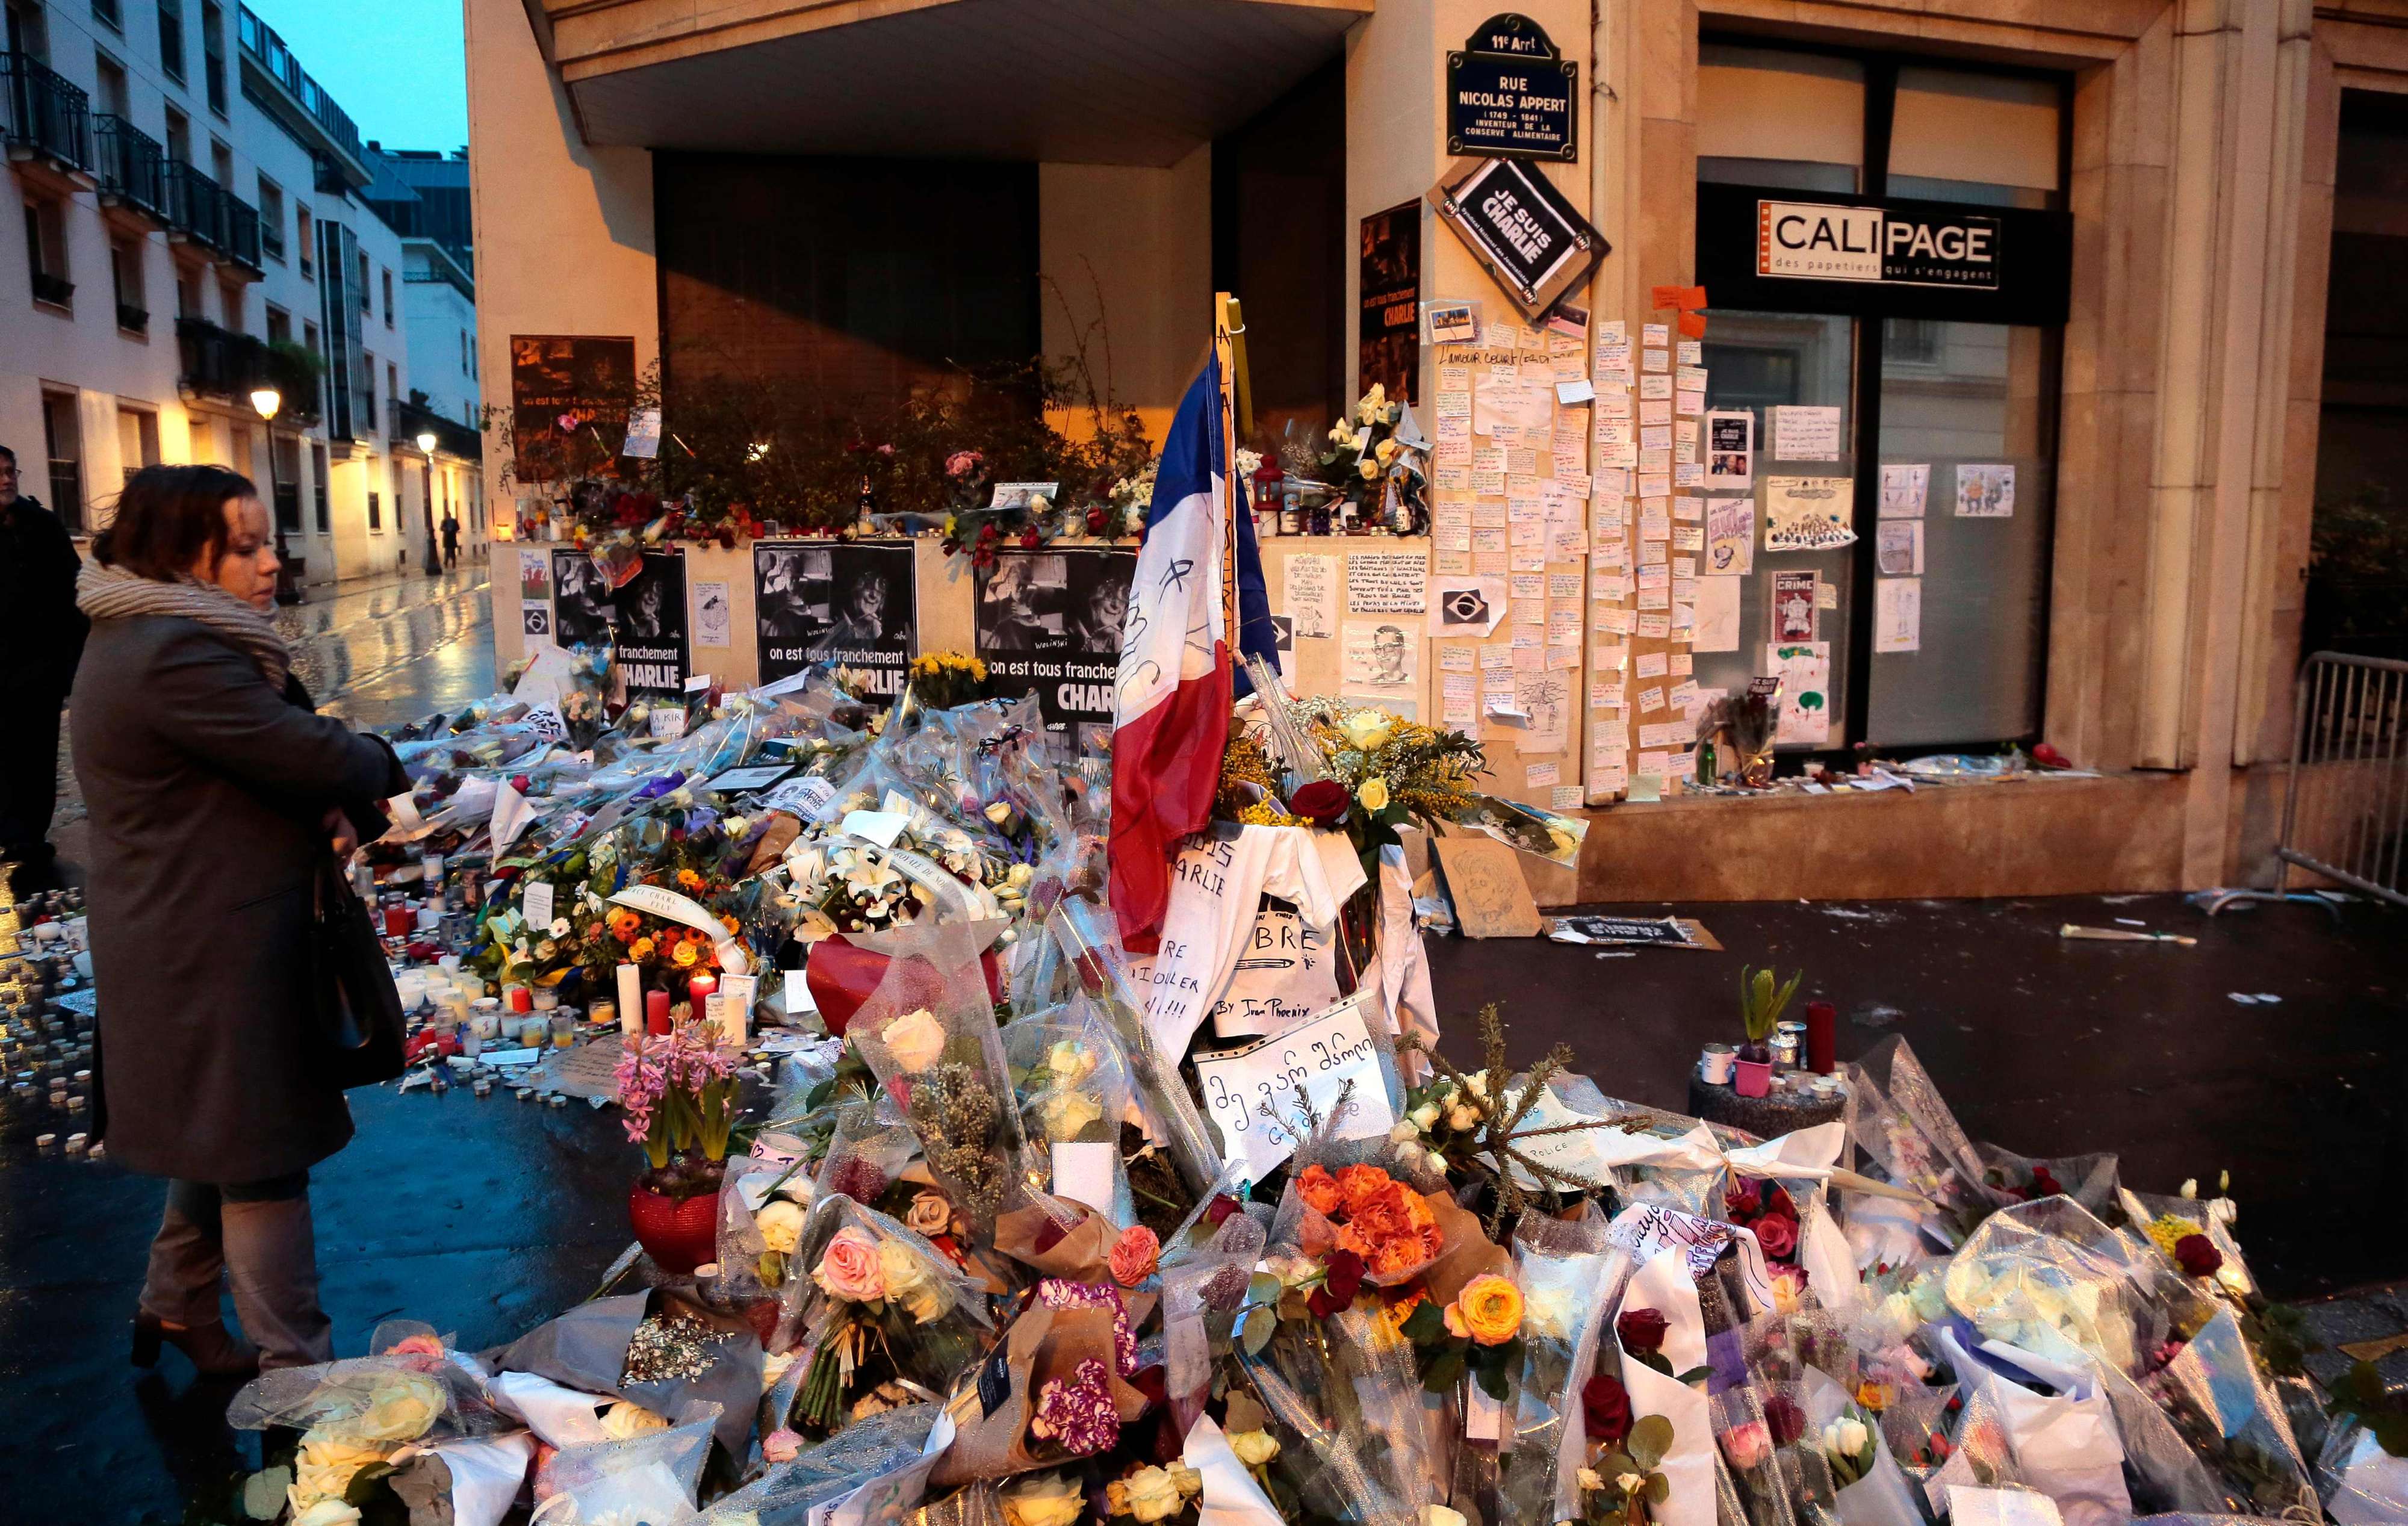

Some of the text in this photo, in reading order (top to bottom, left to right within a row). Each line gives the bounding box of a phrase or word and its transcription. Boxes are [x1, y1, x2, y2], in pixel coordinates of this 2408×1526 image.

[1500, 76, 1528, 91] RUE
[1459, 91, 1566, 112] NICOLAS APPERT
[1476, 119, 1517, 129] INVENTEUR
[1465, 127, 1561, 141] CONSERVE ALIMENTAIRE
[1495, 190, 1552, 249] JE SUIS
[1482, 197, 1543, 265] CHARLIE
[1461, 207, 1530, 284] Syndicat National des Journalistes
[1776, 257, 1992, 280] des papetiers qui s'engagent
[1384, 302, 1415, 327] CHARLIE
[1777, 580, 1813, 590] CRIME
[619, 645, 678, 660] franchement
[770, 647, 904, 664] on est tous franchement
[624, 664, 680, 689] HARLIE
[991, 662, 1006, 674] on
[1010, 660, 1029, 675] est
[1033, 661, 1061, 677] tous
[1170, 858, 1225, 898] ARLIE
[1214, 1000, 1234, 1015] BY
[1264, 998, 1310, 1017] Phoenix
[1530, 1142, 1568, 1158] POLICE
